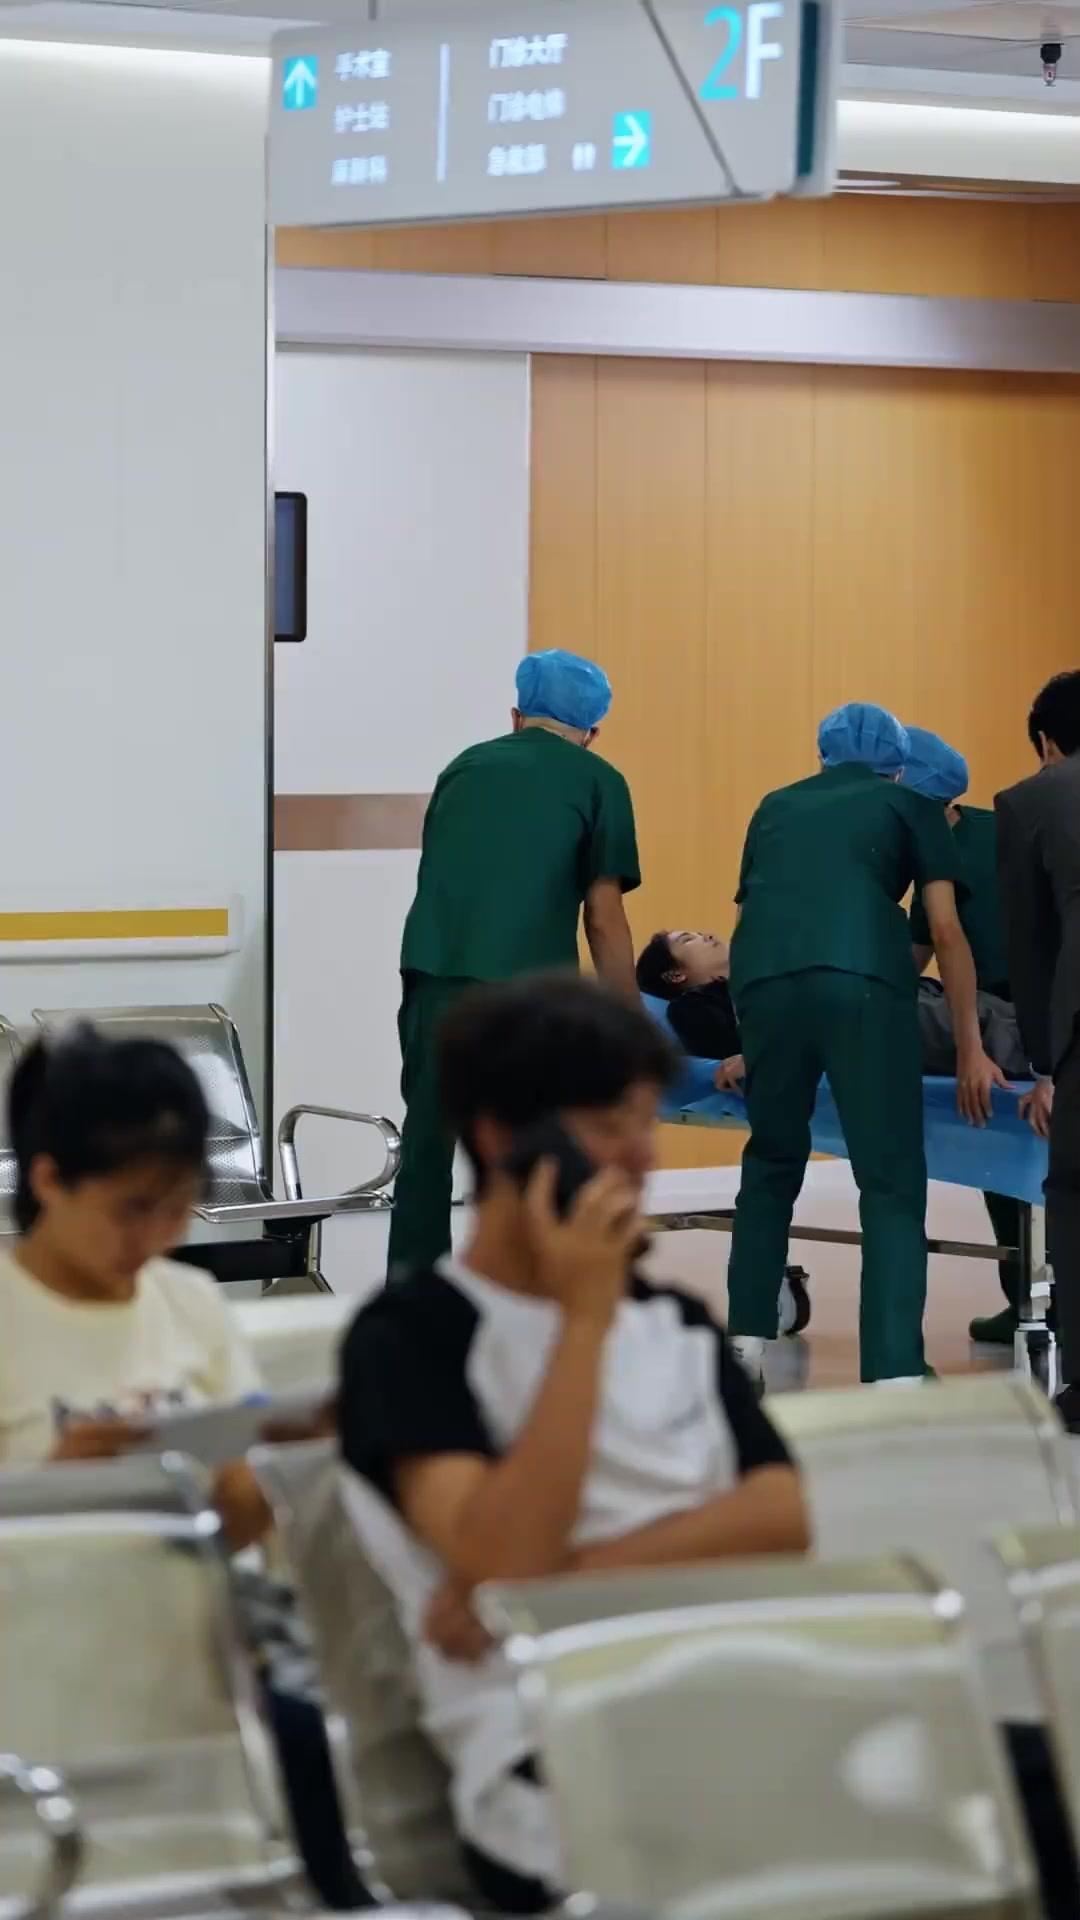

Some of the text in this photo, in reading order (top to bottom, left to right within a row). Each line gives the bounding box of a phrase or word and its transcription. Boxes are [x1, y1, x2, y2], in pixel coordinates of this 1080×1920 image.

[334, 48, 392, 81] 手术室
[489, 32, 568, 68] 门诊大厅
[700, 3, 784, 100] 2F
[333, 102, 391, 134] 护士站
